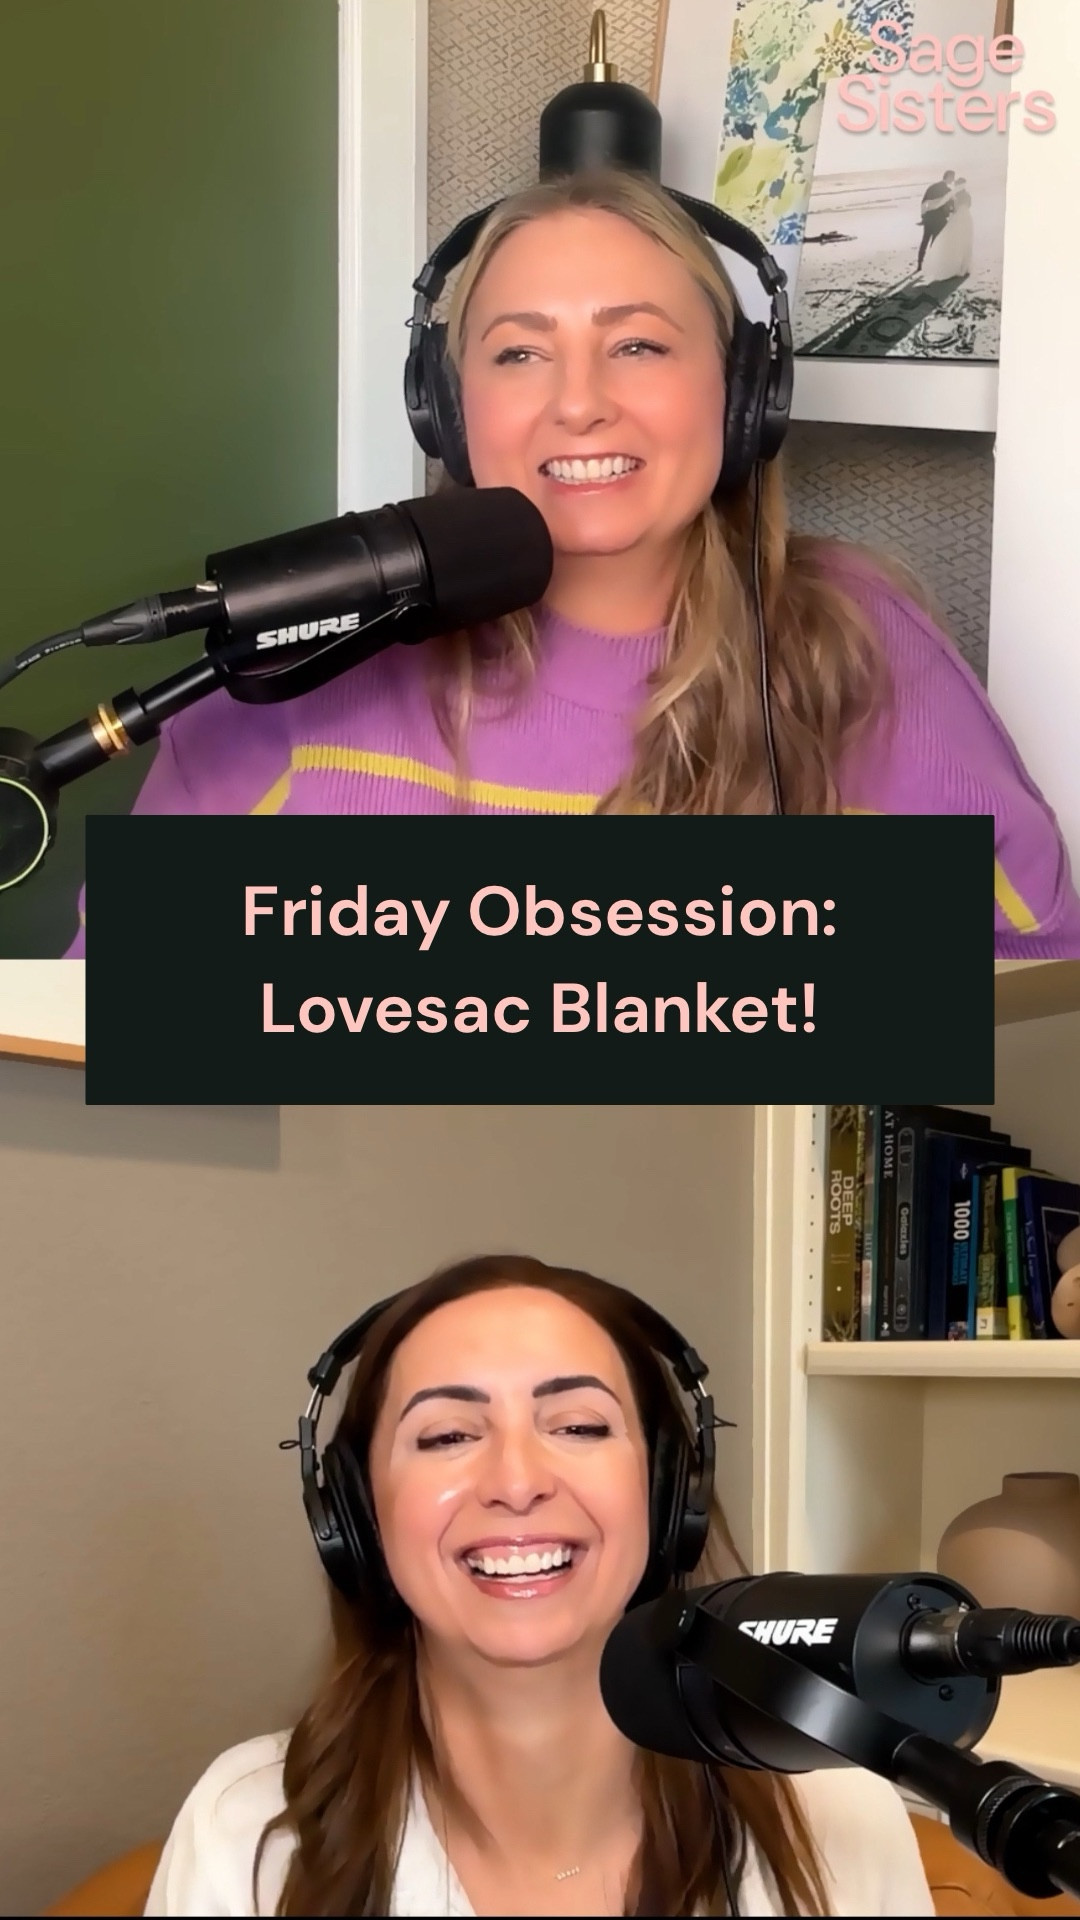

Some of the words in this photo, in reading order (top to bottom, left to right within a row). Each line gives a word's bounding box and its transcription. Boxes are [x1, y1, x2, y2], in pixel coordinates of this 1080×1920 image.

[256, 612, 360, 650] SHURE
[885, 1110, 895, 1128] AT
[883, 1134, 895, 1179] HOME
[830, 1170, 842, 1235] ROOTS
[842, 1176, 854, 1225] DEEP
[953, 1200, 971, 1240] 1000
[899, 1207, 909, 1255] Galaxies
[738, 1618, 838, 1646] SHURE
